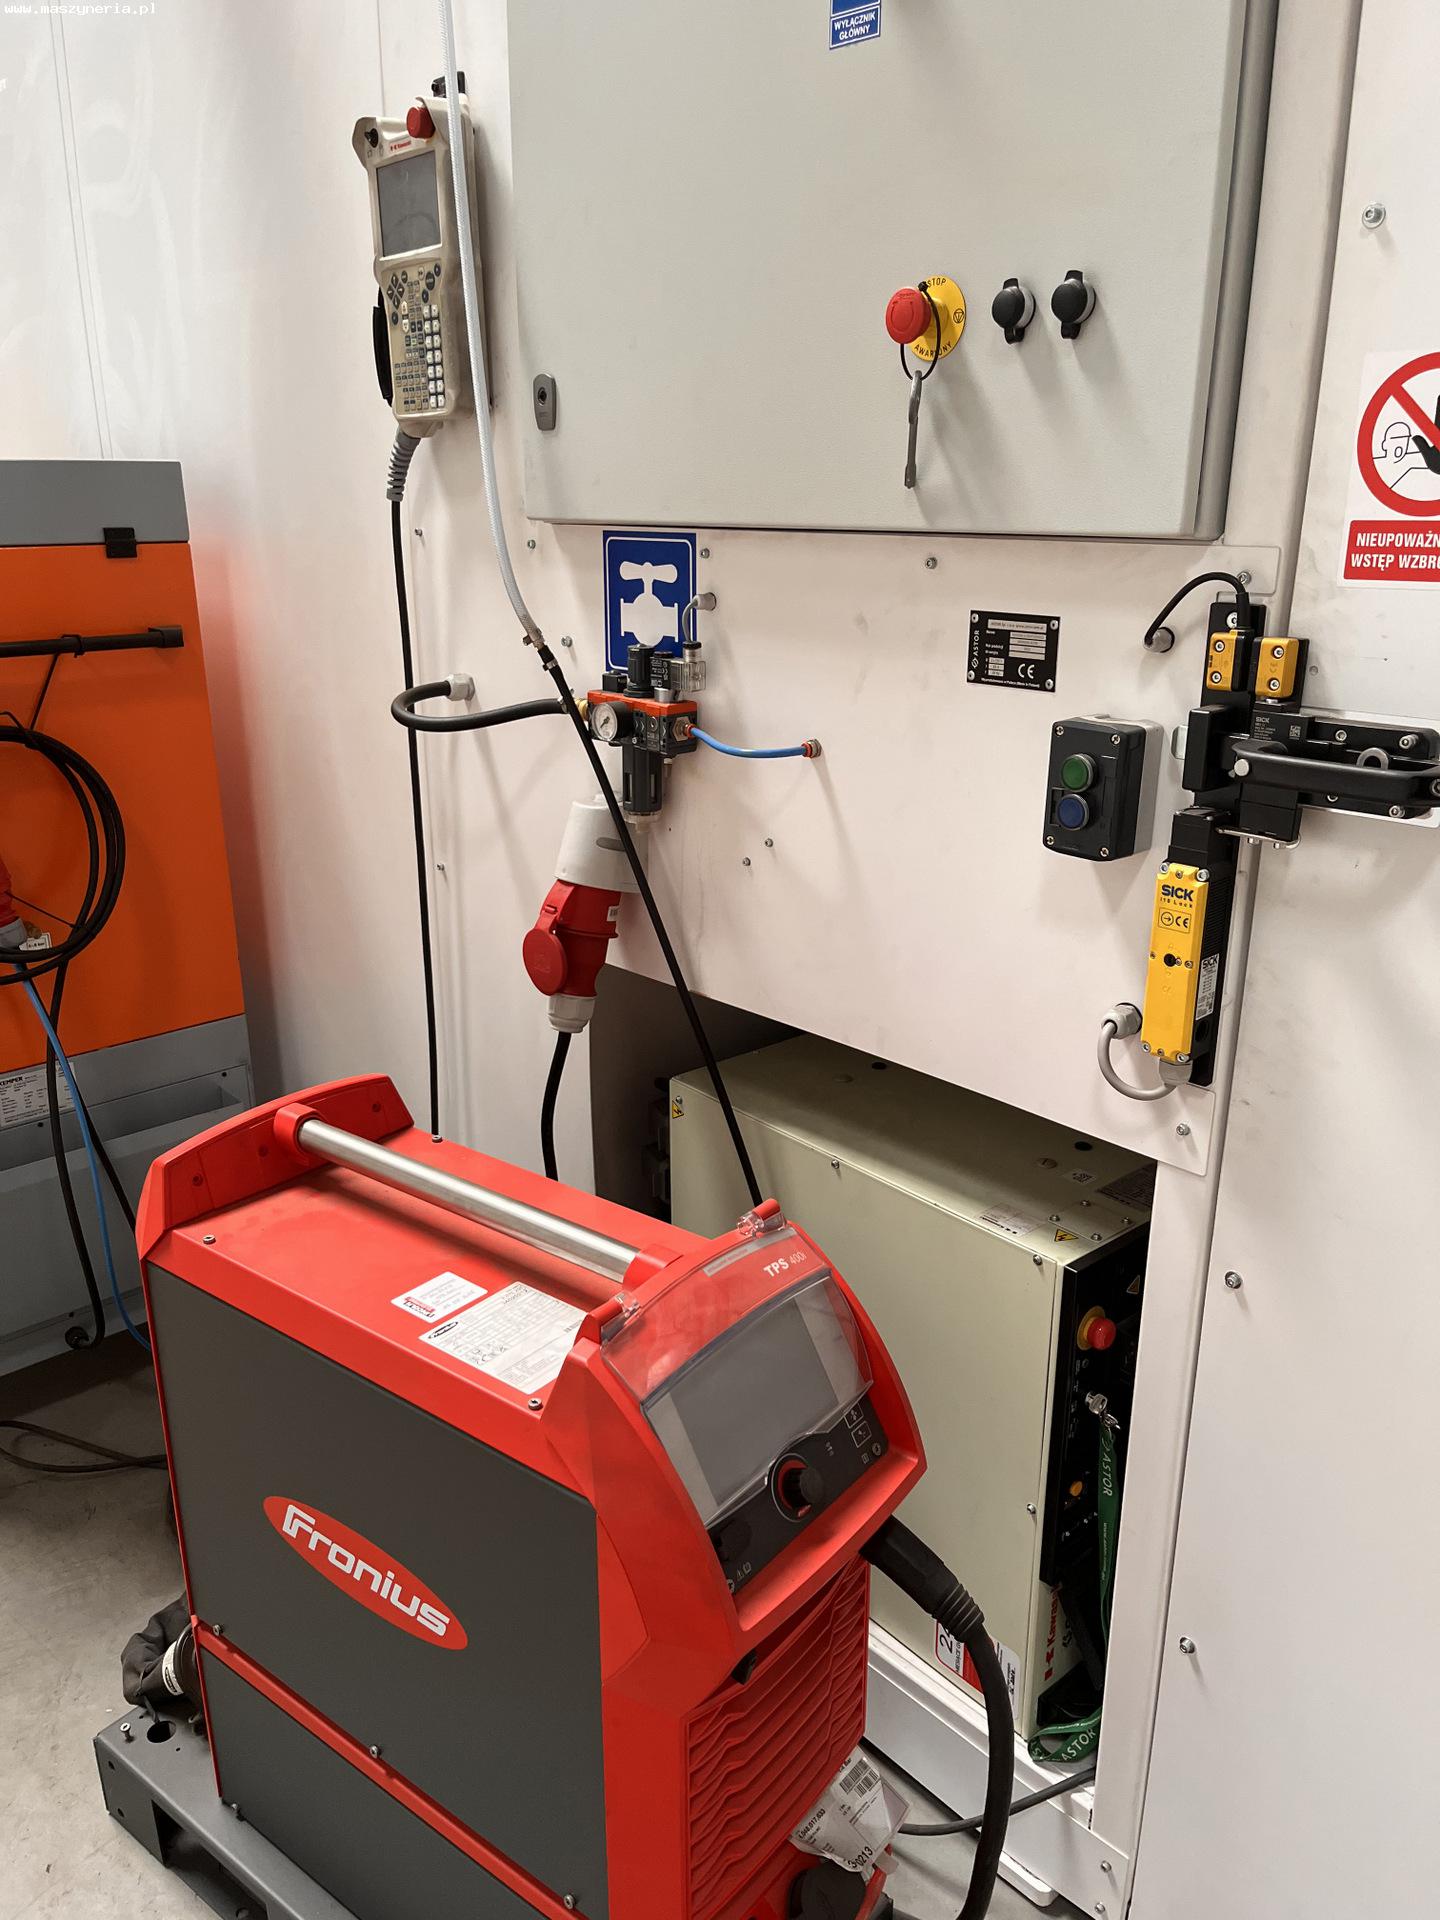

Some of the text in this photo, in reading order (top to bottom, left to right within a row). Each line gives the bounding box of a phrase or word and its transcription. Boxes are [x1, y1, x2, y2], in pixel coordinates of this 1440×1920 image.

[833, 11, 876, 31] WYŁĄCZNIK
[839, 24, 870, 40] GŁÓWNY
[927, 277, 947, 288] STOP
[1351, 553, 1395, 571] WSTĘP
[1255, 716, 1270, 724] SICK
[1161, 884, 1194, 902] SICK
[763, 1258, 789, 1277] TPS
[1102, 1454, 1113, 1497] ASTOR
[282, 1504, 450, 1636] Fronius
[1061, 1728, 1097, 1761] ASTOR
